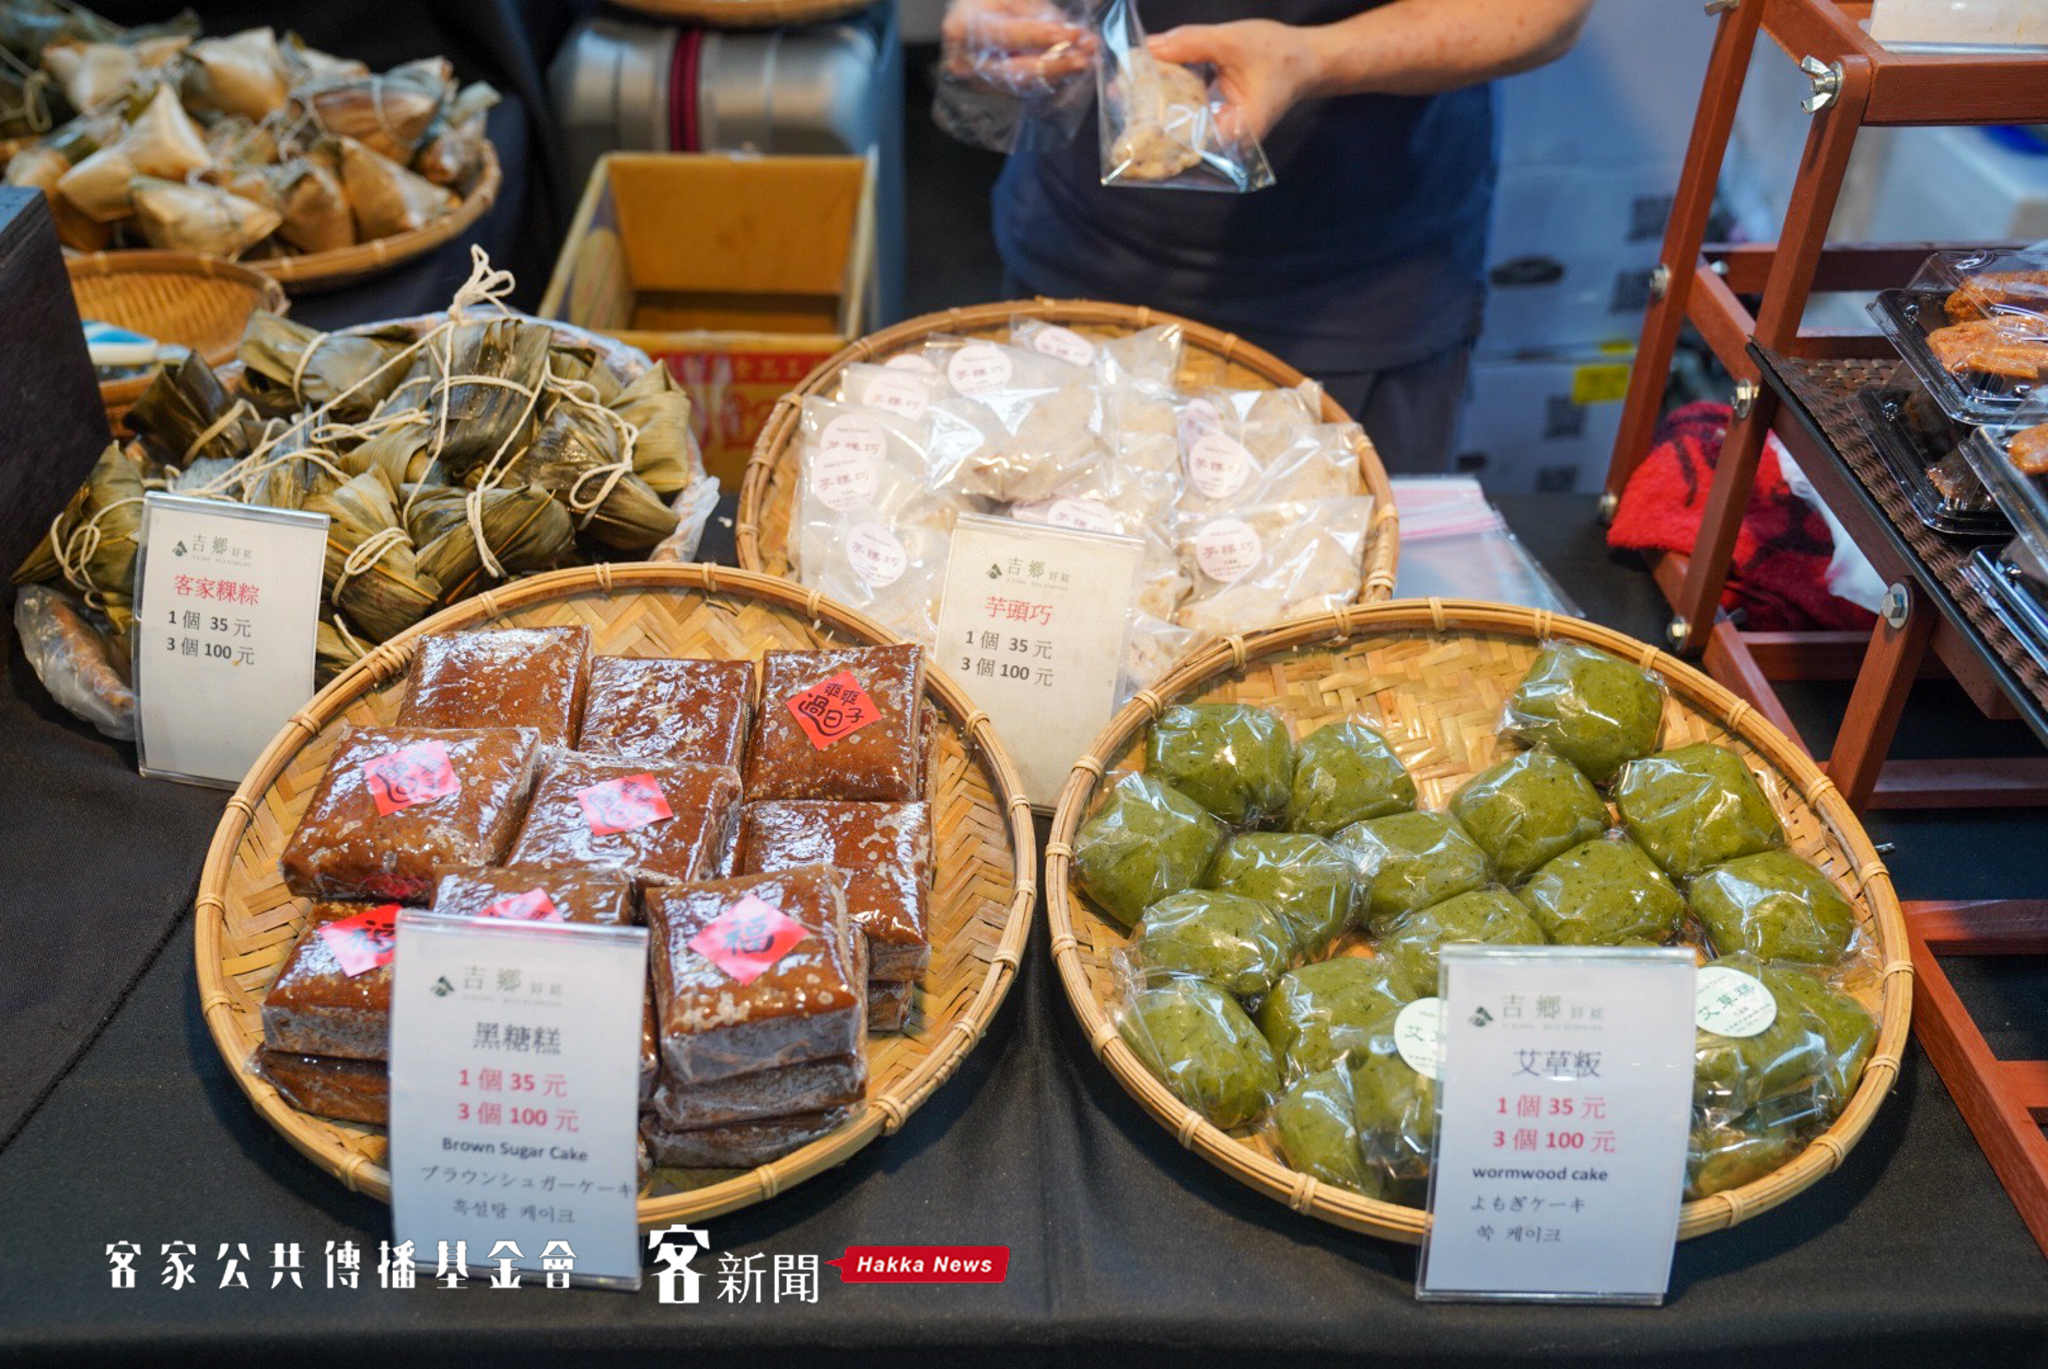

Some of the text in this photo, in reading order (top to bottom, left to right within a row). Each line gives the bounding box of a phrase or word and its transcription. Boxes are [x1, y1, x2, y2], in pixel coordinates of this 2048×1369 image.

[173, 574, 260, 606] 客家粿粽
[168, 610, 252, 638] 1 個 35 元
[984, 595, 1054, 626] 芋頭巧
[166, 637, 255, 666] 3 個 100 元
[965, 630, 1053, 660] 1 個 35 元
[960, 656, 1054, 687] 3 個 100 元
[472, 1021, 562, 1055] 黑糖糕
[458, 1067, 568, 1098] 1 個 35 元
[458, 1101, 579, 1133] 3 個 100 元
[1496, 1094, 1606, 1120] 1 個 35 元
[442, 1137, 588, 1162] Brown Sugar Cake
[1493, 1128, 1616, 1153] 3 個 100 元
[421, 1164, 635, 1199] ブラウンシュガーケーキ
[1472, 1166, 1608, 1182] wormwood cake
[453, 1199, 576, 1224] 흑설탕 케이크
[1471, 1196, 1586, 1213] よもぎケーキ
[1476, 1225, 1561, 1243] 쑥 케이크
